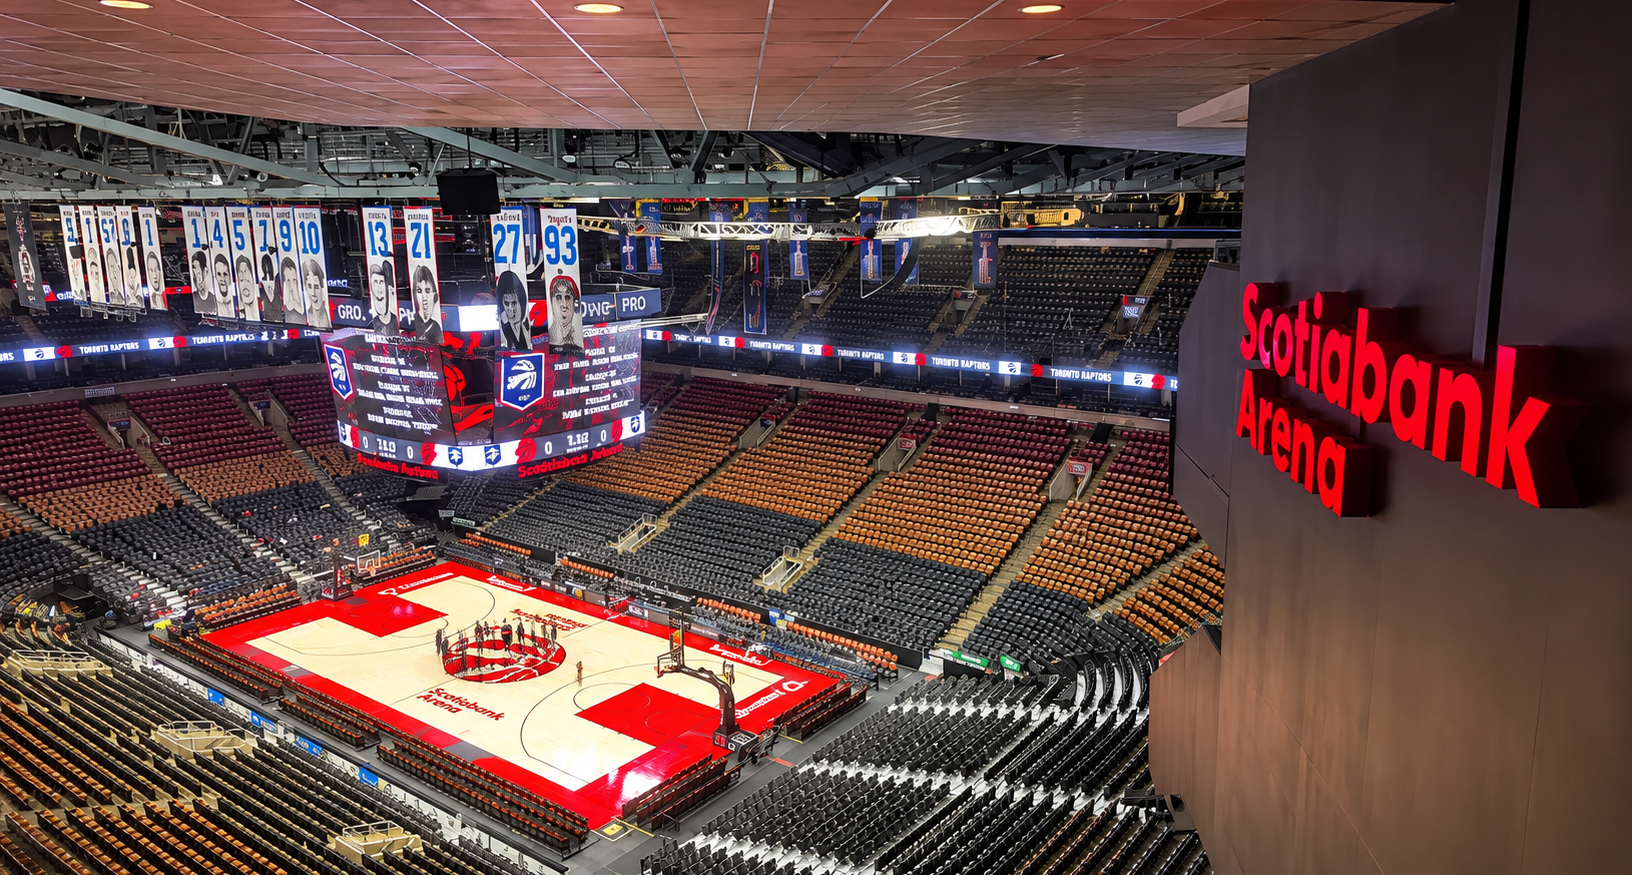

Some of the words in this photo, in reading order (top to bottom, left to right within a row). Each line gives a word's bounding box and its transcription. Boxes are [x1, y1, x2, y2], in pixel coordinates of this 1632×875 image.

[145, 219, 154, 246] 1
[191, 218, 202, 248] 1
[213, 219, 224, 248] 4
[232, 219, 246, 251] 5
[279, 219, 292, 252] 9
[299, 220, 321, 255] 10
[367, 221, 389, 257] 13
[410, 222, 431, 259] 21
[493, 223, 520, 264] 27
[544, 225, 577, 265] 93
[622, 296, 646, 312] PRO
[1240, 282, 1551, 508] Scotiabank
[362, 435, 369, 449] 0
[544, 441, 553, 455] 0
[600, 429, 607, 442] 0
[1235, 368, 1347, 517] Arena
[406, 445, 414, 459] 0
[416, 694, 463, 713] Arena
[429, 687, 505, 721] Scotiabank
